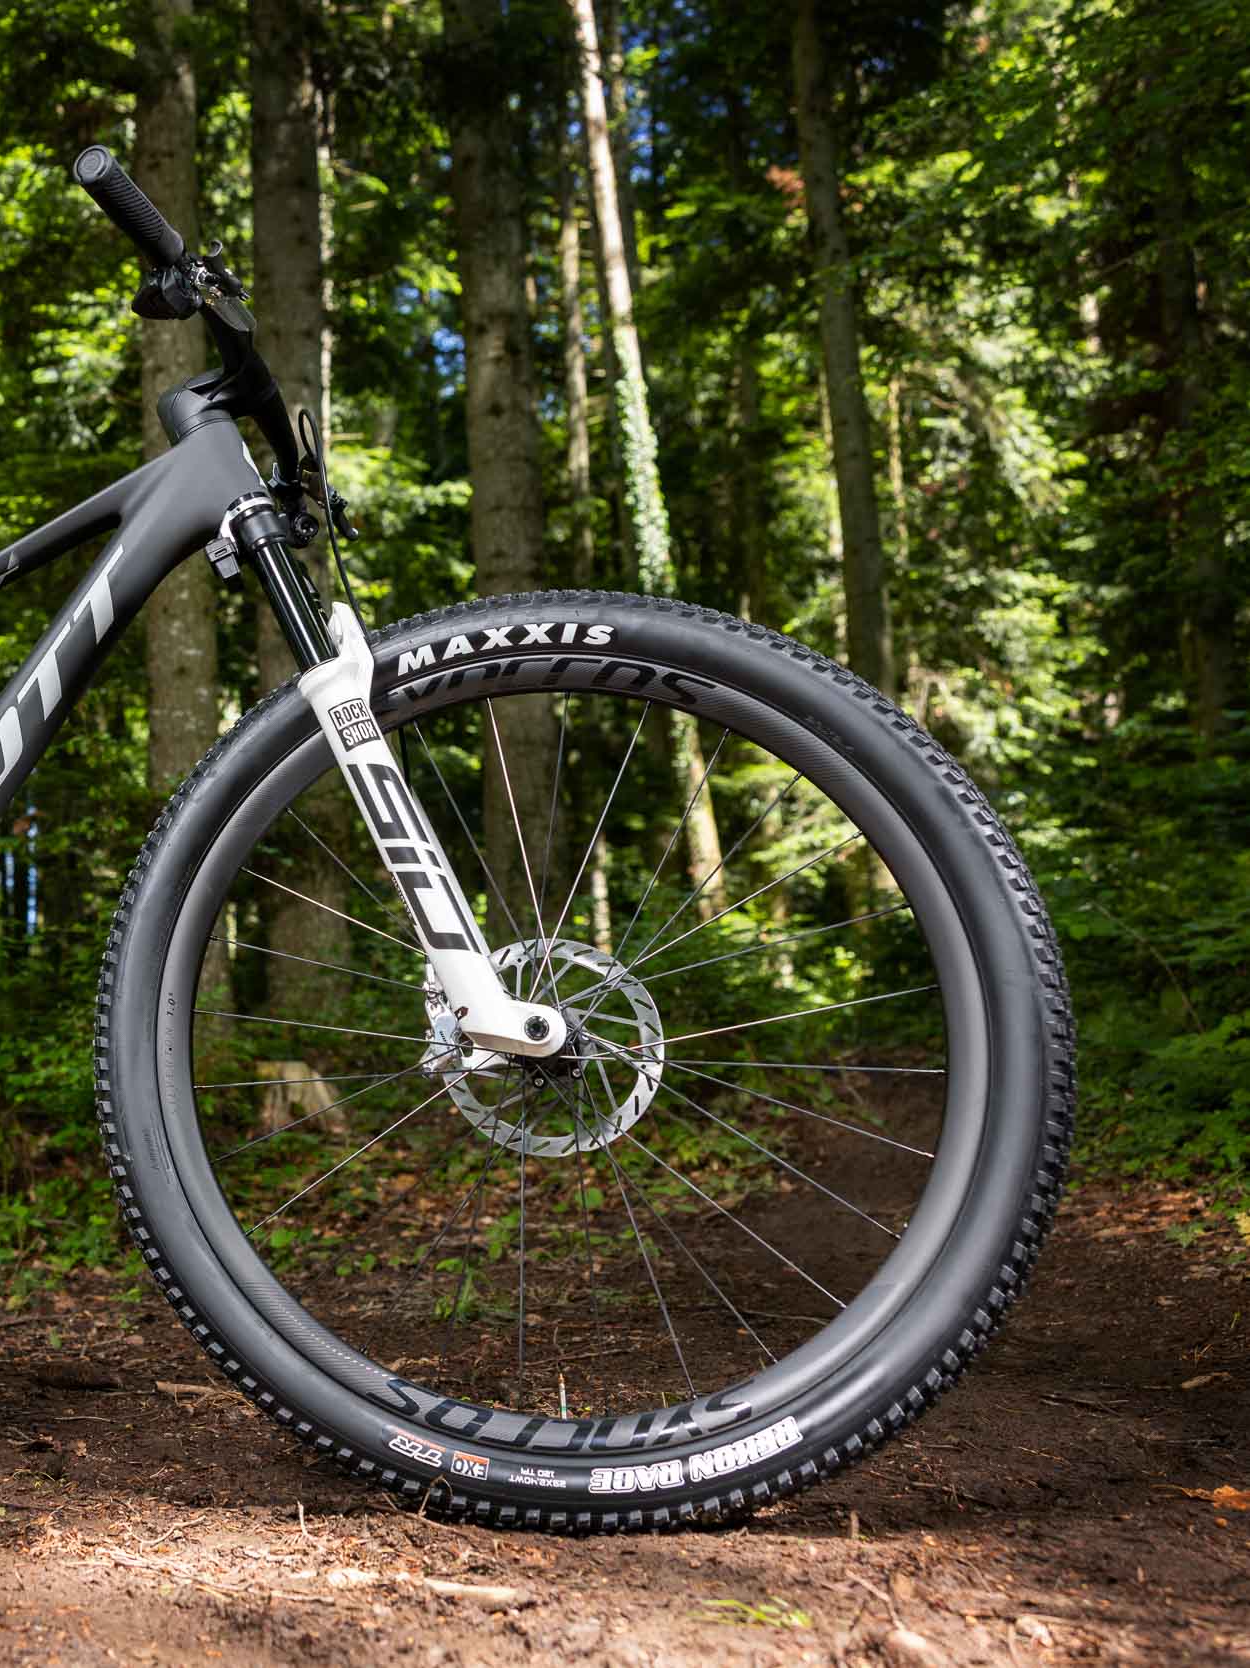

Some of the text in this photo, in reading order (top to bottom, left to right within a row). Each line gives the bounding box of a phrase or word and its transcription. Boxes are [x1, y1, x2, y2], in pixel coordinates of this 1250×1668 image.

[398, 622, 615, 677] MAXXIS
[333, 702, 368, 727] ROCK
[342, 721, 377, 746] SHOX
[388, 1434, 443, 1468] TR
[588, 1415, 805, 1495] REKON RACE
[452, 1458, 488, 1478] EXO
[520, 1467, 555, 1479] 120 TPI
